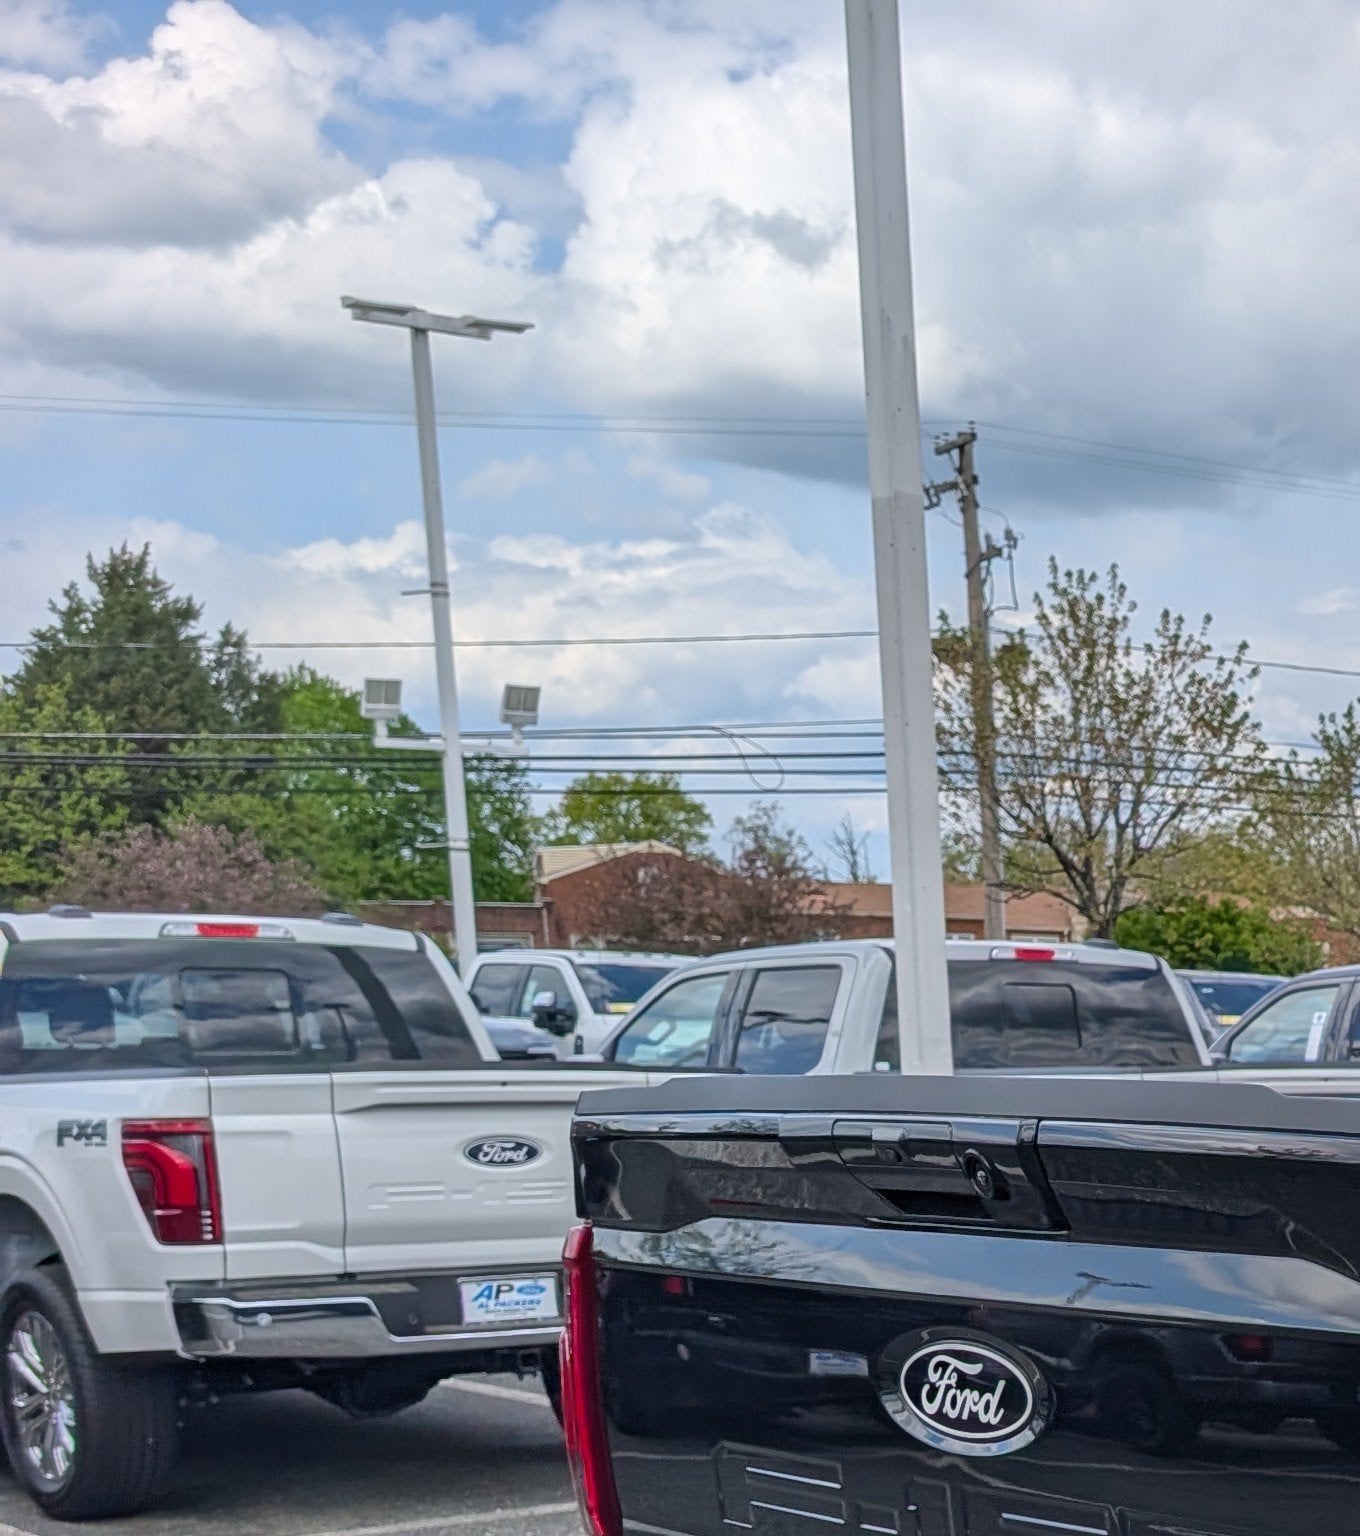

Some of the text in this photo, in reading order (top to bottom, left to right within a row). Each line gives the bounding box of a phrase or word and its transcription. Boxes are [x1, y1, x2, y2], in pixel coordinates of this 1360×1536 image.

[57, 1119, 107, 1146] FX4
[478, 1141, 527, 1162] Ford
[472, 1283, 514, 1301] AP
[921, 1354, 1006, 1425] Ford
